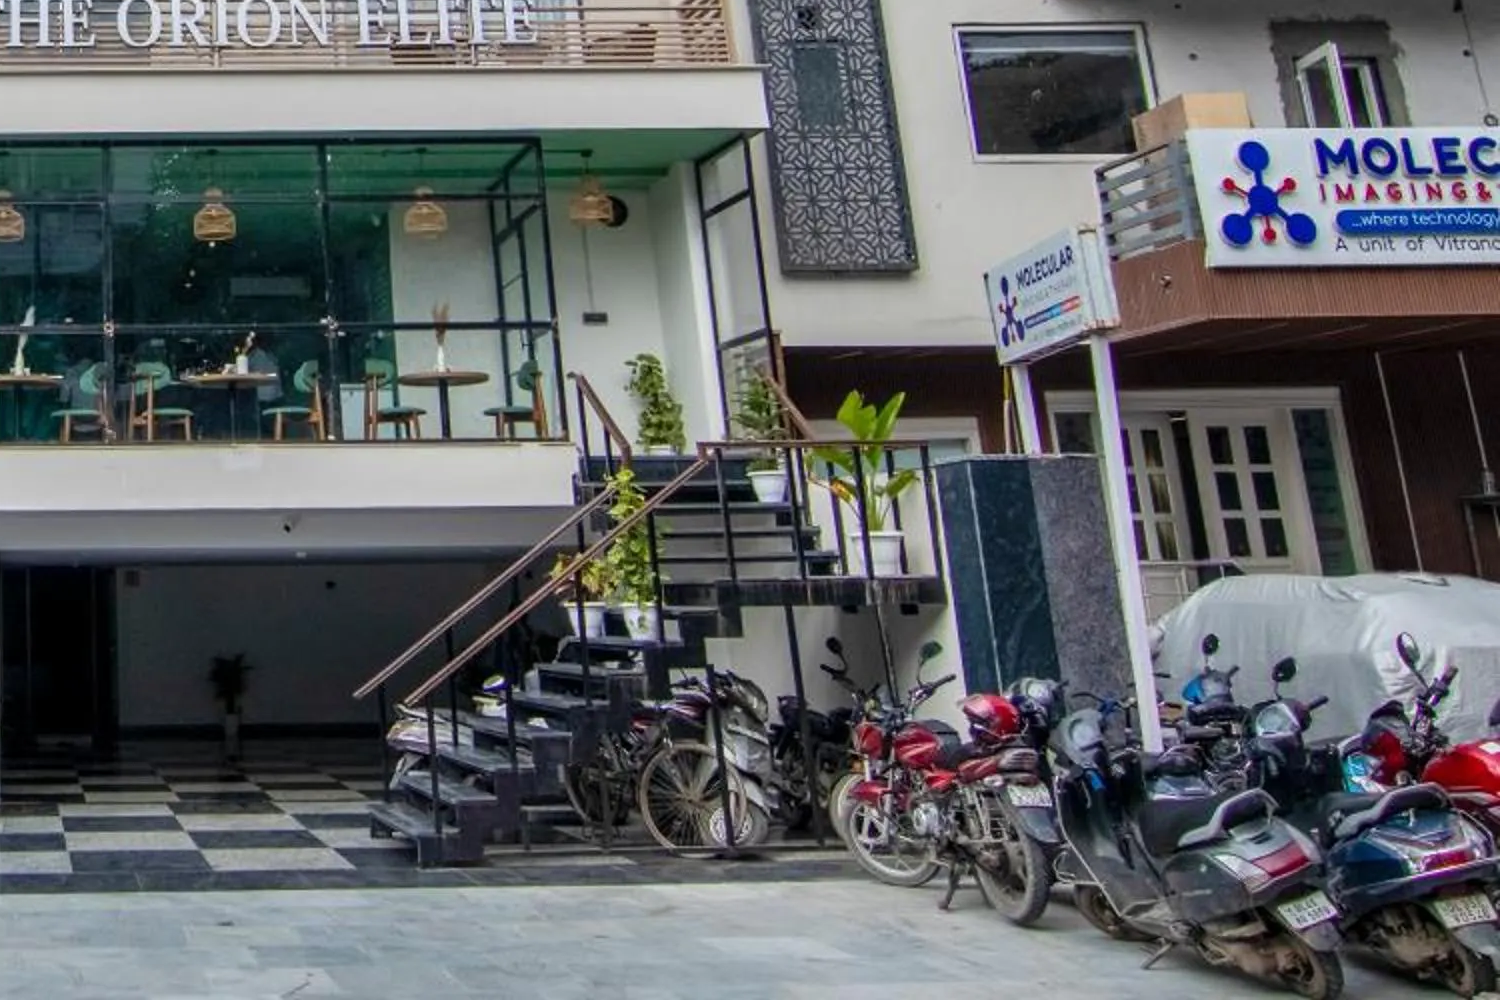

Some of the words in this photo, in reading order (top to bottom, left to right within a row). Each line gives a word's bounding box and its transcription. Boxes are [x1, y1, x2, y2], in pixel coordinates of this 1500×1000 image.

[1313, 137, 1500, 177] MOLEC
[1411, 210, 1500, 230] technology
[1335, 236, 1349, 252] A
[1359, 235, 1396, 252] unit
[1405, 234, 1425, 252] of
[1015, 244, 1075, 290] MOLECULAR
